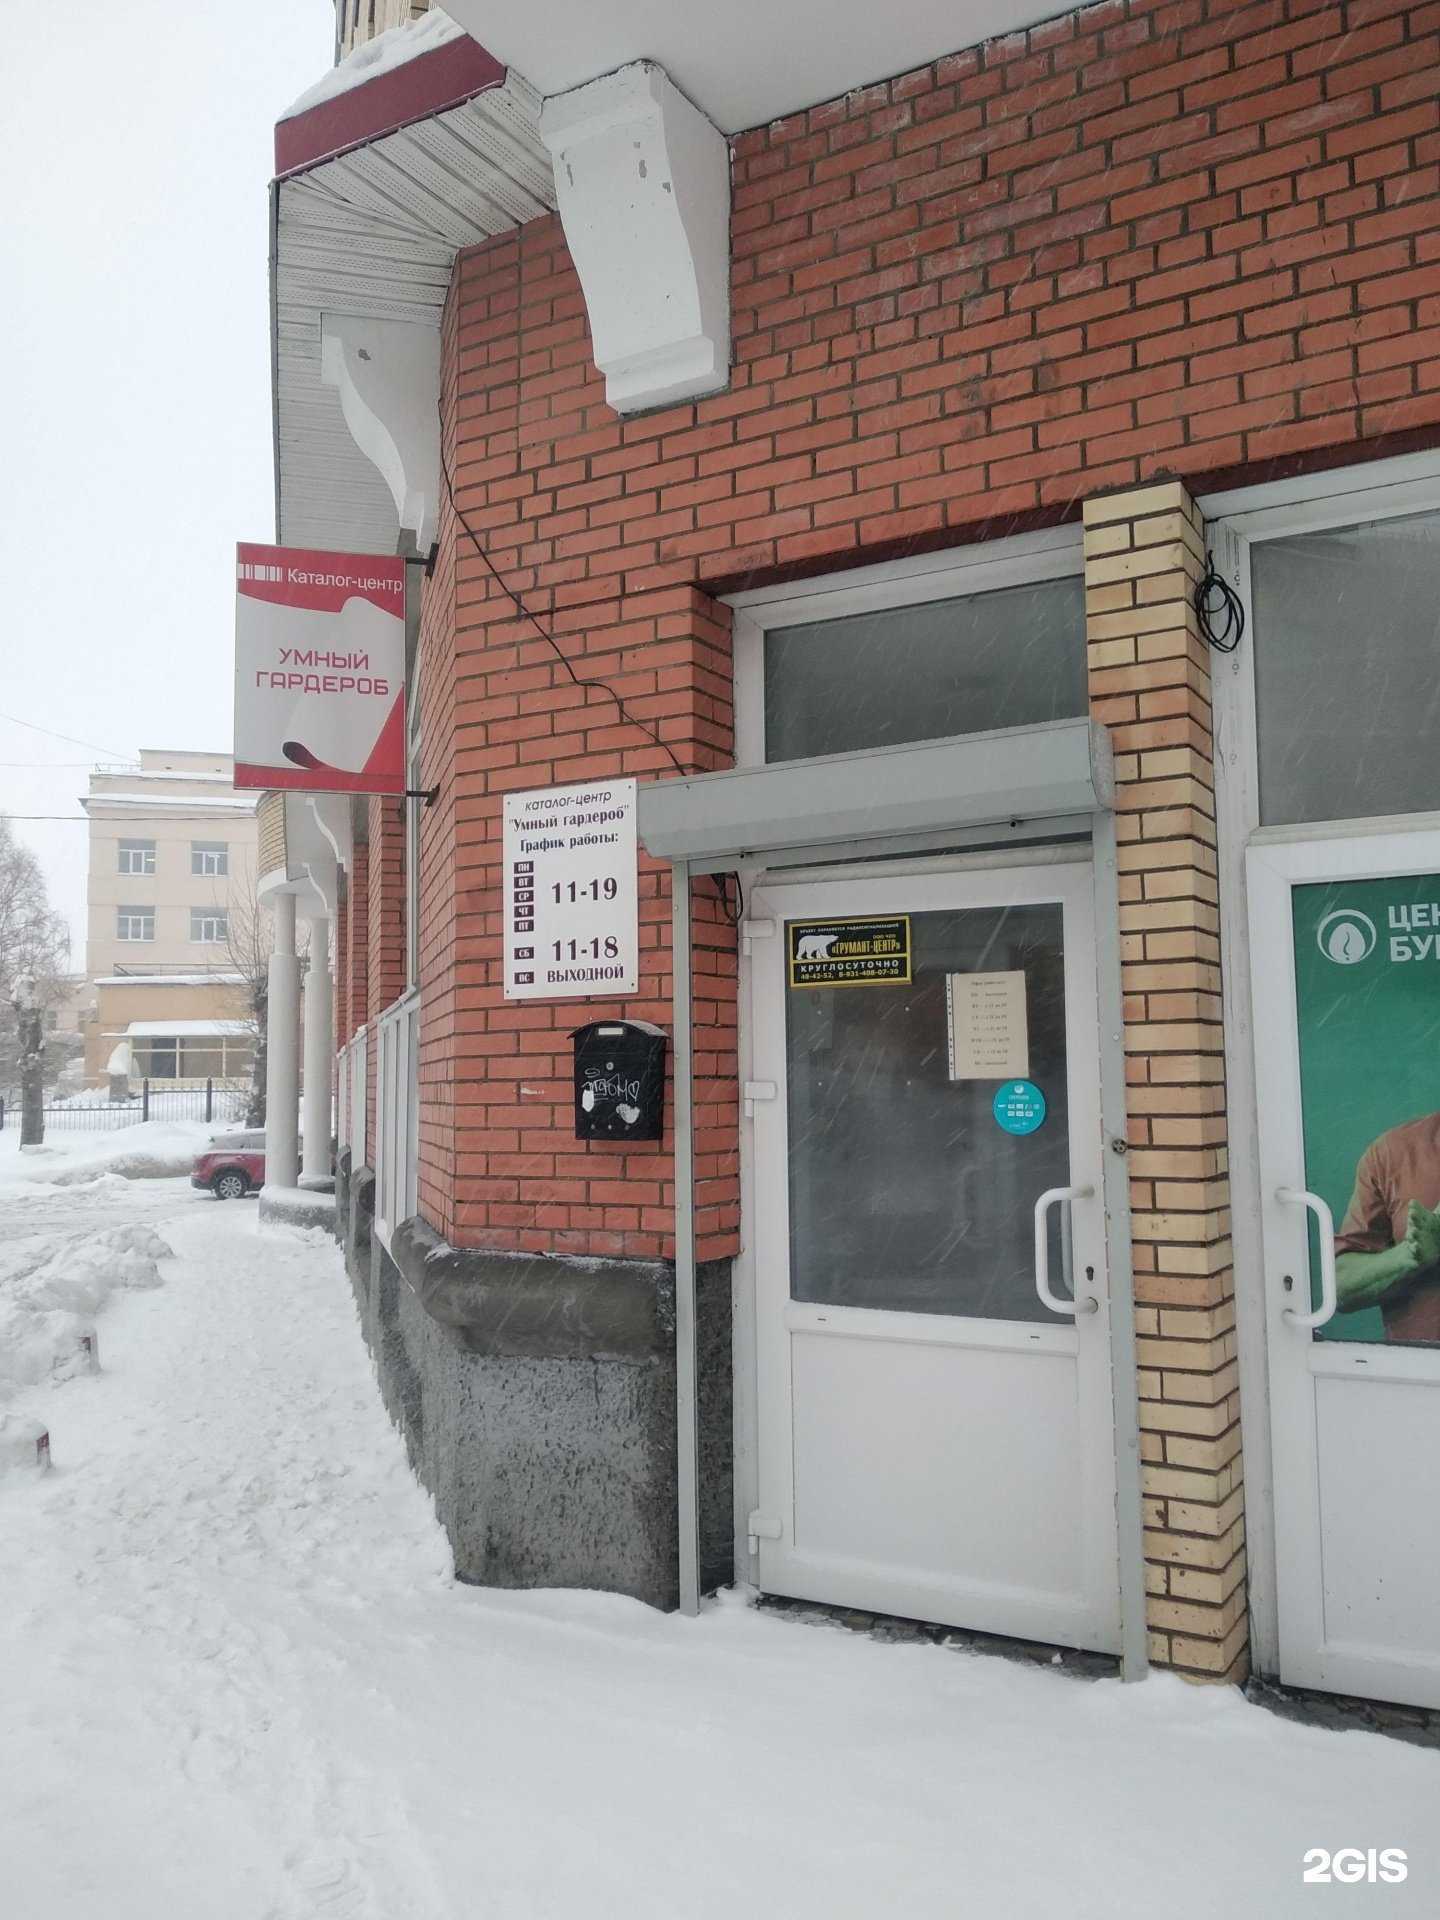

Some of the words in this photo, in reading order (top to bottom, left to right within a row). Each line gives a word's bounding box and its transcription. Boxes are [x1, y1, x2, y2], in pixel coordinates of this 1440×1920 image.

[288, 568, 403, 594] Каталог-центр
[279, 648, 369, 671] УМНЫЙ
[256, 671, 389, 696] ГАРДЕРОБ
[525, 791, 612, 811] каталог-центр
[520, 837, 565, 854] График
[569, 832, 619, 850] работы:
[518, 863, 530, 872] ПН
[518, 877, 529, 887] ВТ
[552, 877, 618, 904] 11-19
[518, 892, 530, 902] СР
[518, 906, 529, 916] ЧТ
[518, 921, 529, 931] ПТ
[518, 949, 530, 958] СБ
[552, 936, 619, 962] 11-18
[1390, 934, 1440, 962] БУ
[547, 963, 625, 983] ВЫХОДНОЙ
[801, 960, 899, 973] КРУГЛОСУТОЧНО
